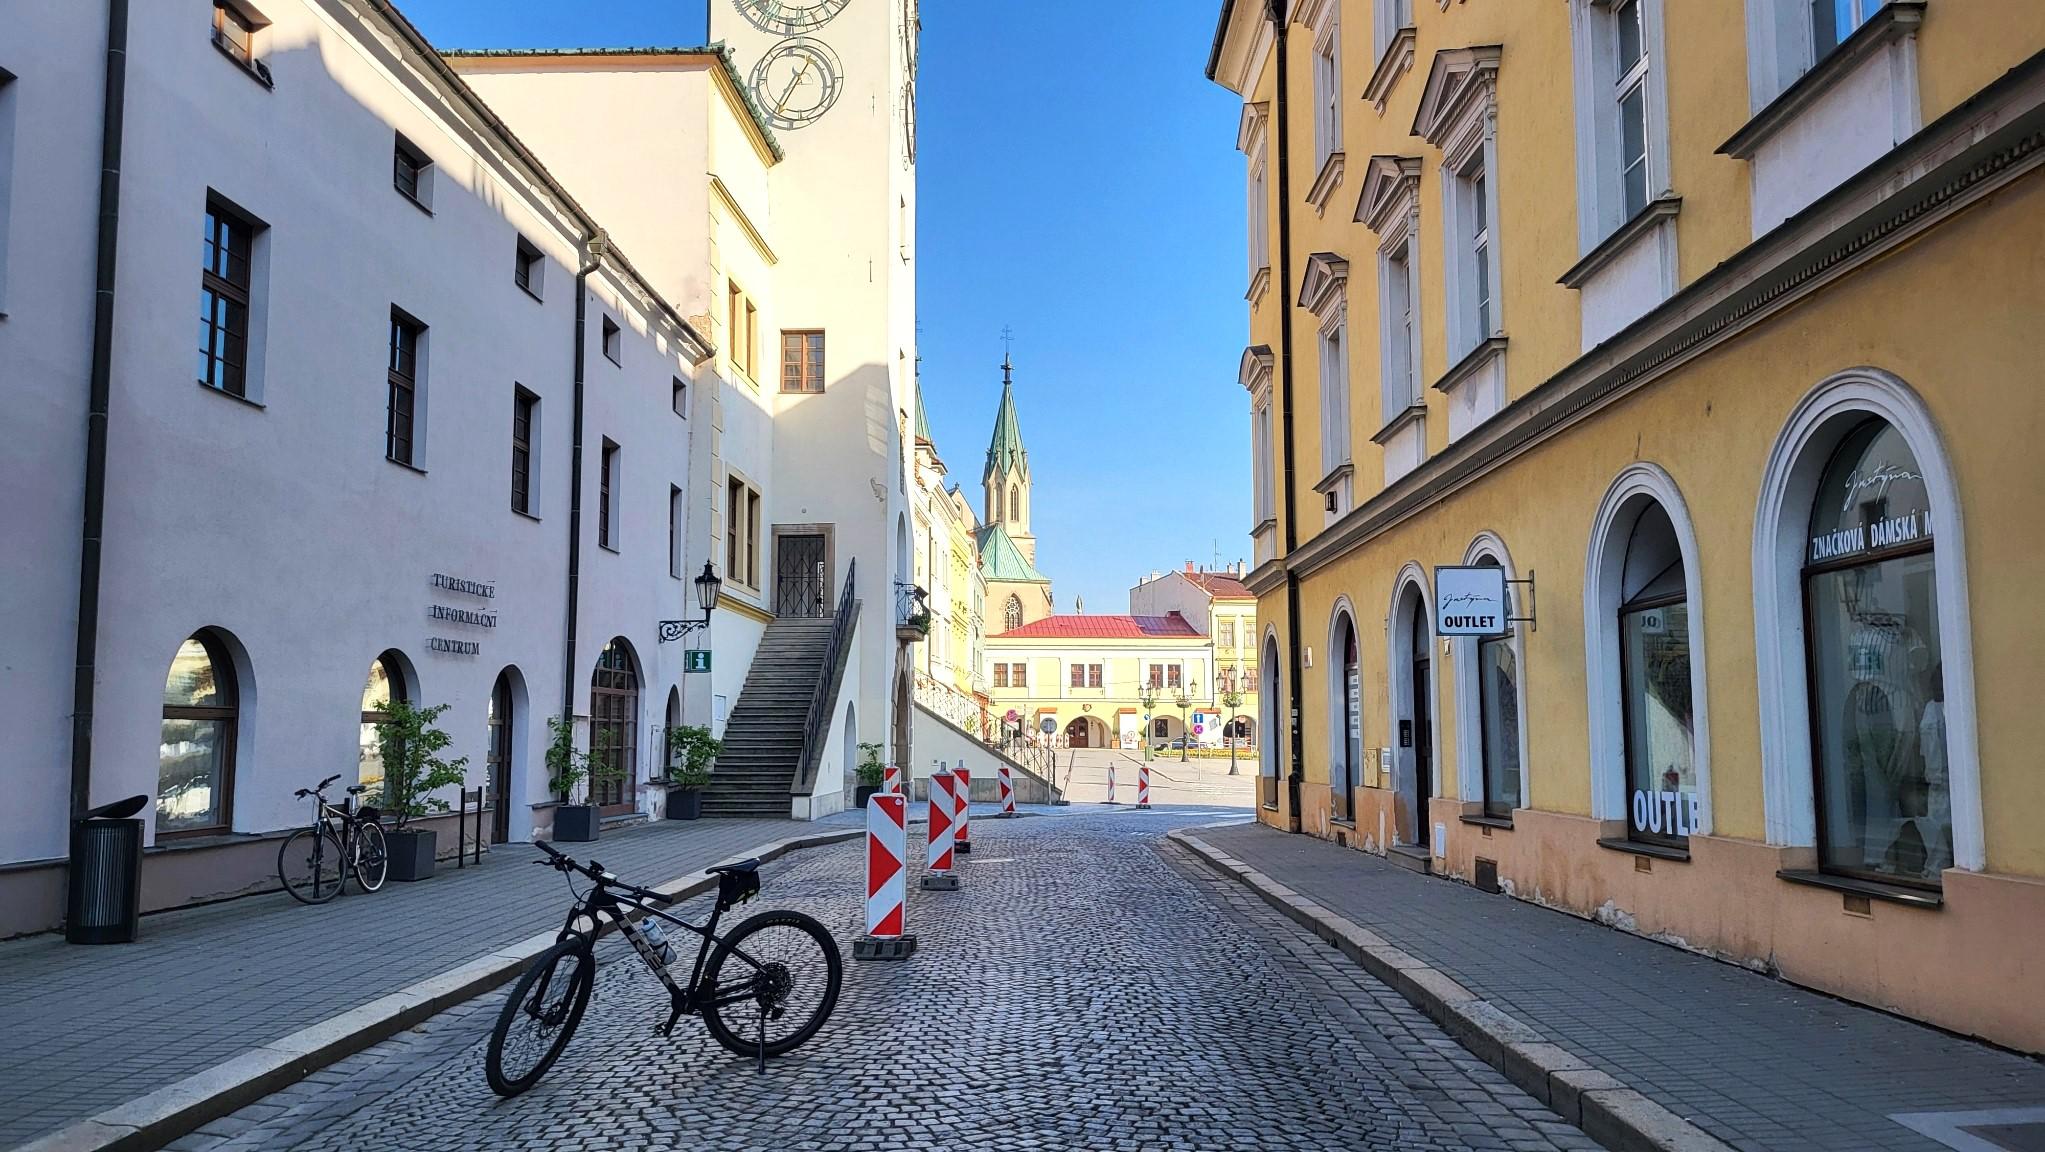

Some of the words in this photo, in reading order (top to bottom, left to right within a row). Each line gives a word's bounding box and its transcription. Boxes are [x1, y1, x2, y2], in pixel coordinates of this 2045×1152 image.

[1813, 522, 1865, 560] ZNAČKOVÁ
[1870, 509, 1917, 548] DÁMSKÁ
[1444, 616, 1495, 628] OUTLET
[430, 637, 480, 655] CENTRUM
